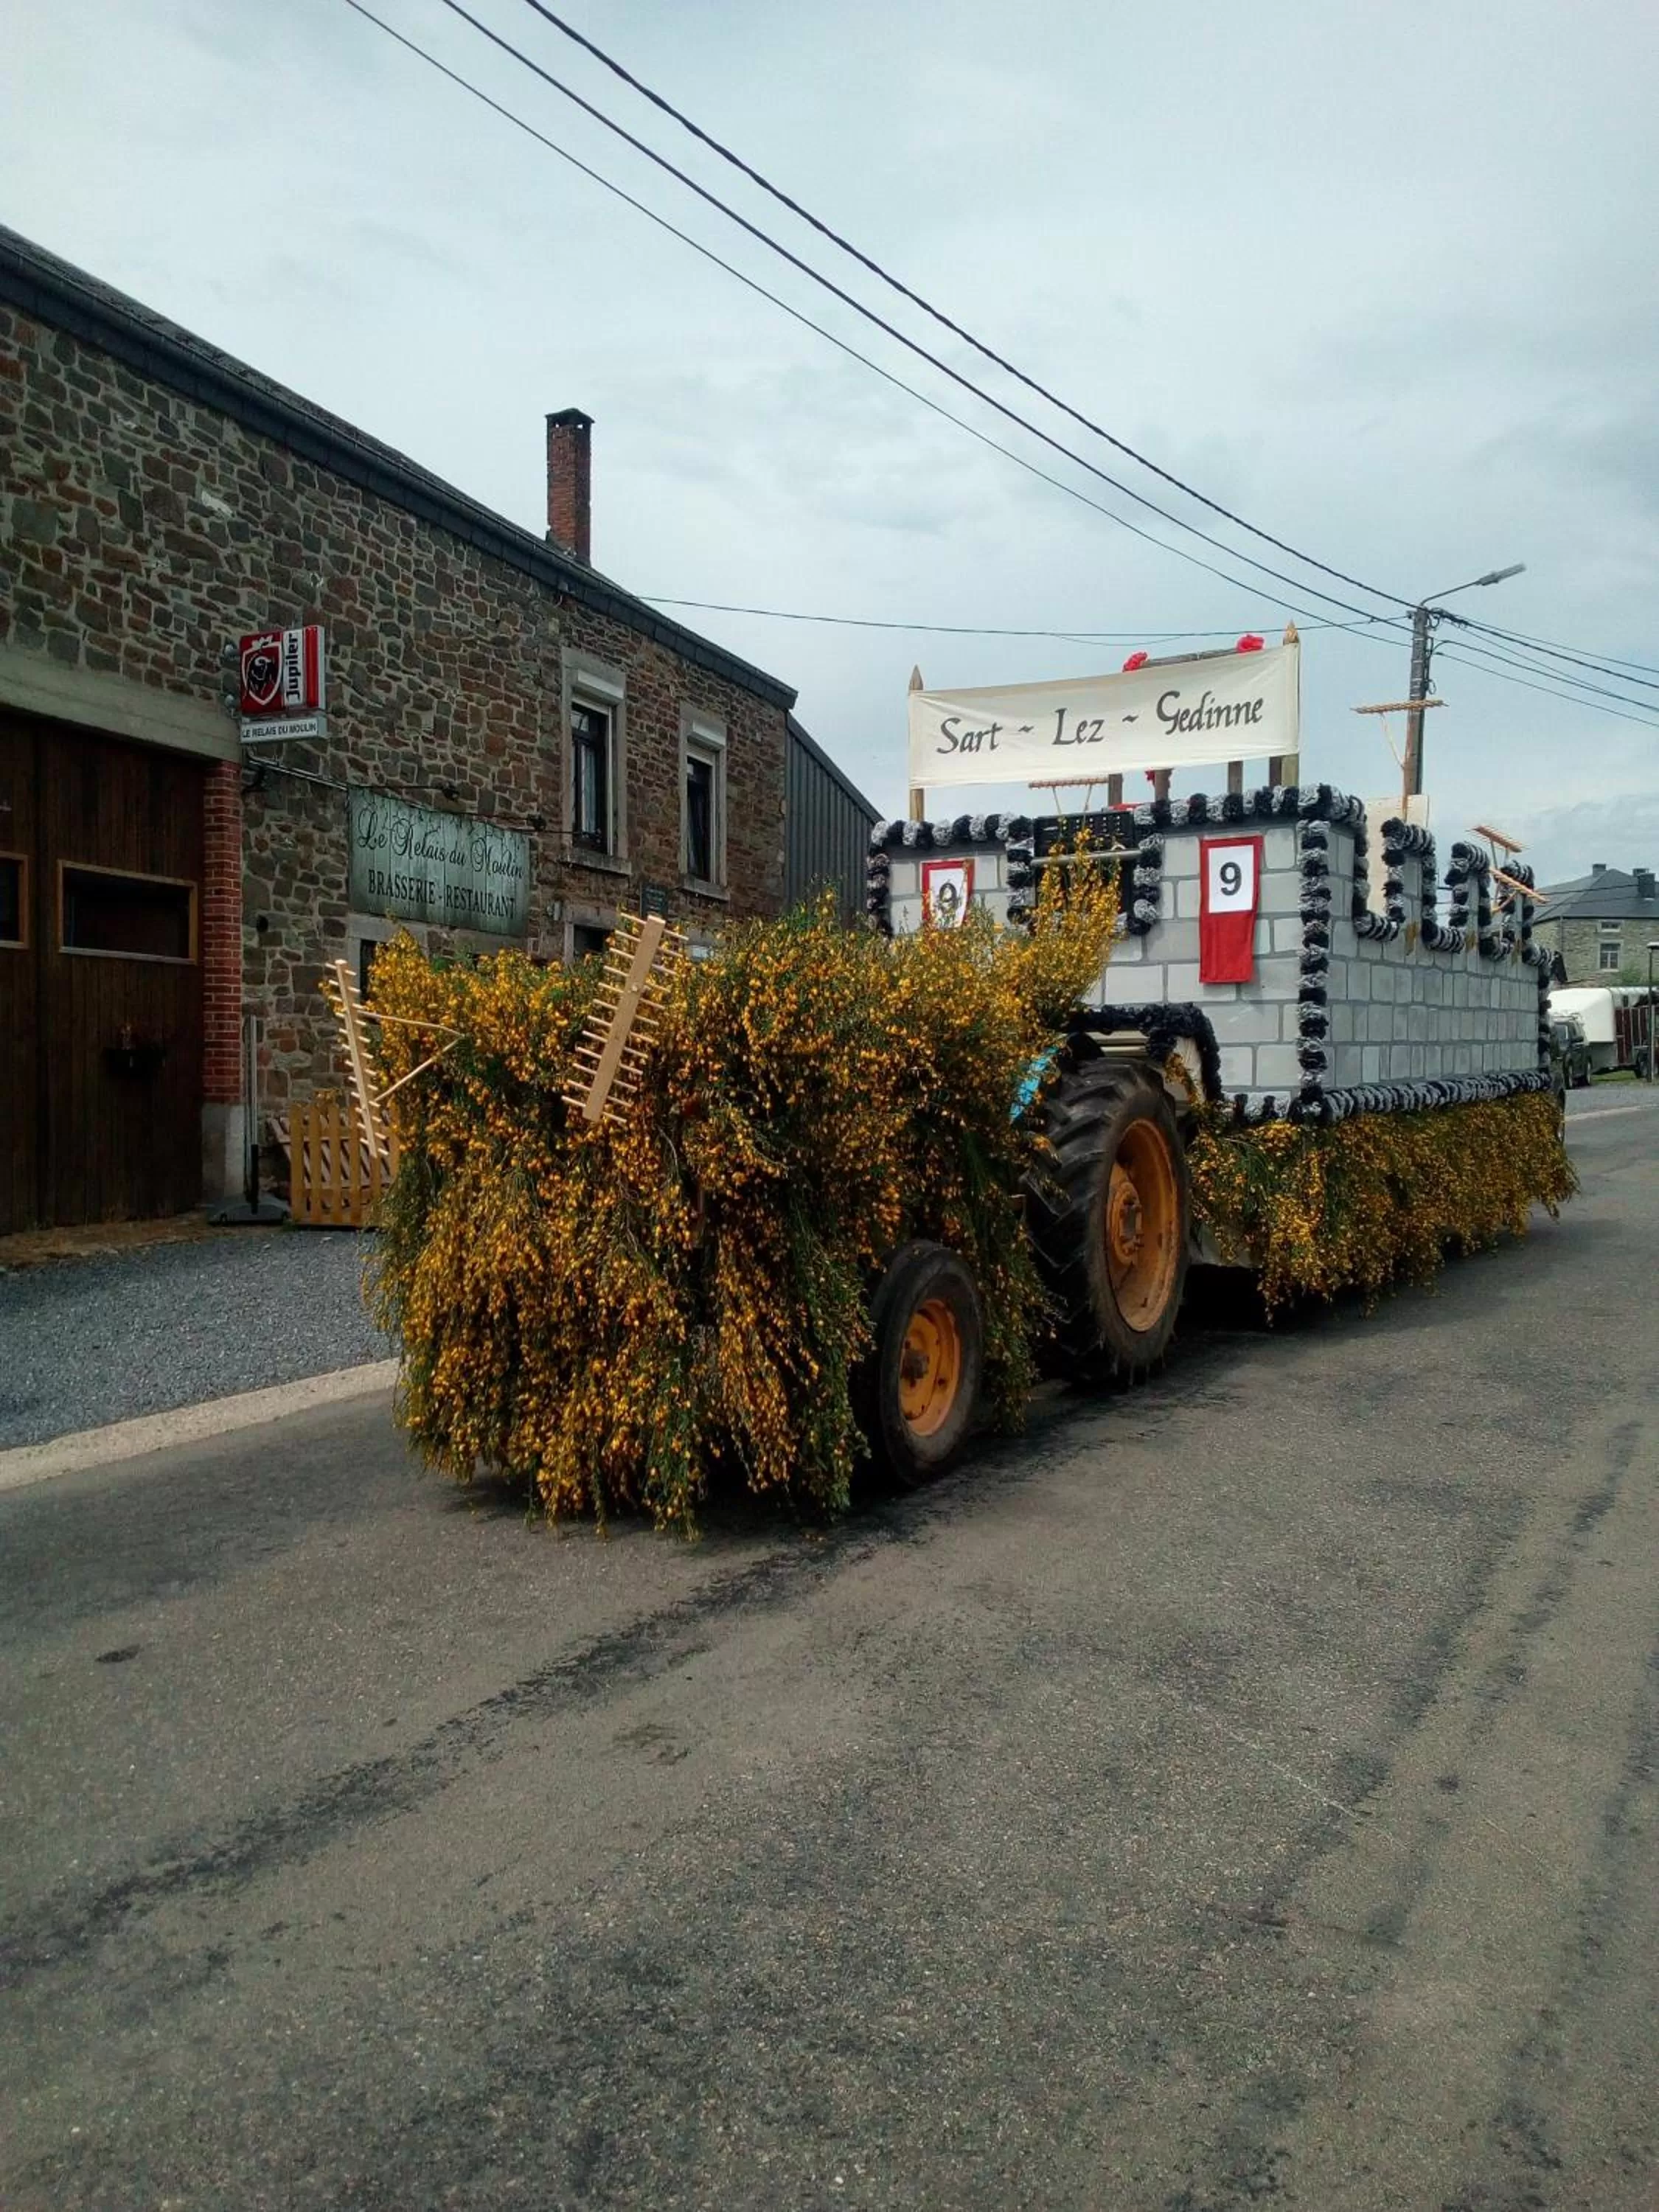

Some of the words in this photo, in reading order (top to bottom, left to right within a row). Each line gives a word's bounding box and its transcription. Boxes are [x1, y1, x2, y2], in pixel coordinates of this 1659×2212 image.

[285, 633, 302, 700] Jupiler
[243, 729, 251, 737] LE
[251, 726, 276, 737] RELAIS
[278, 726, 288, 735] DU
[289, 723, 316, 734] MOULIN
[936, 717, 1003, 754] Sart
[1052, 708, 1105, 746] Lez
[1156, 690, 1264, 735] Gedinne
[358, 808, 388, 849] Le
[392, 818, 445, 862] Relais
[449, 843, 466, 867] du
[470, 837, 524, 880] Moulin
[369, 869, 436, 905] BRASSERIE
[445, 885, 515, 919] RESTAURANT
[1219, 861, 1242, 897] 9
